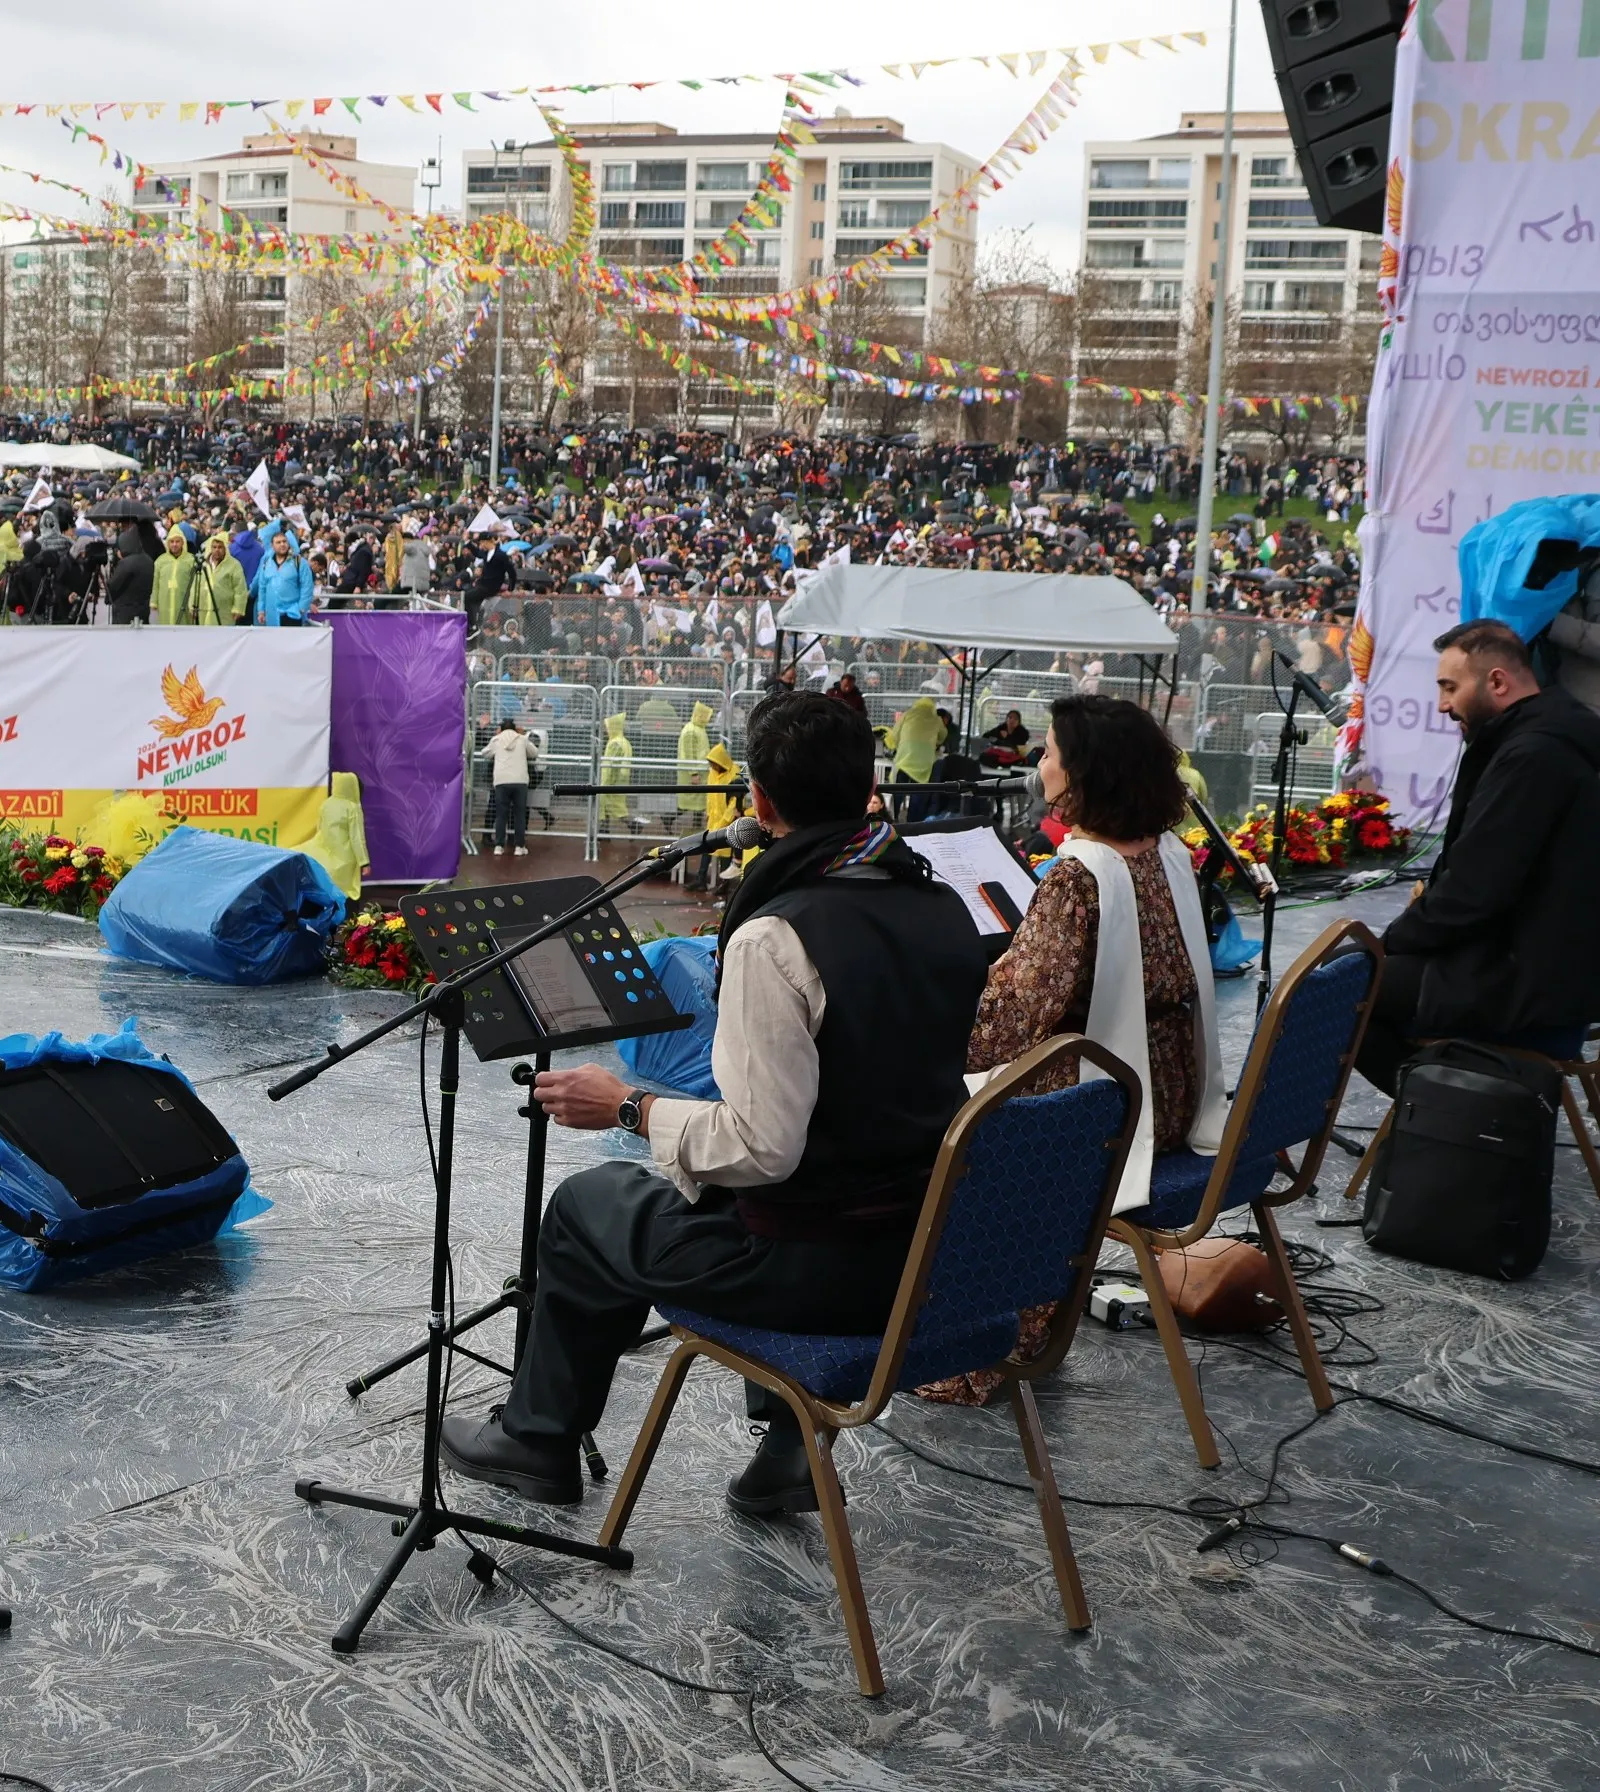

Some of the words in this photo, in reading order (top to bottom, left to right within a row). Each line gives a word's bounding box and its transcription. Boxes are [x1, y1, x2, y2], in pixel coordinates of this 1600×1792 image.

[137, 714, 246, 780] NEWROZ
[163, 762, 194, 787] KUTLU
[194, 750, 228, 775] OLSUN!
[162, 789, 251, 814] GÜRLÜK
